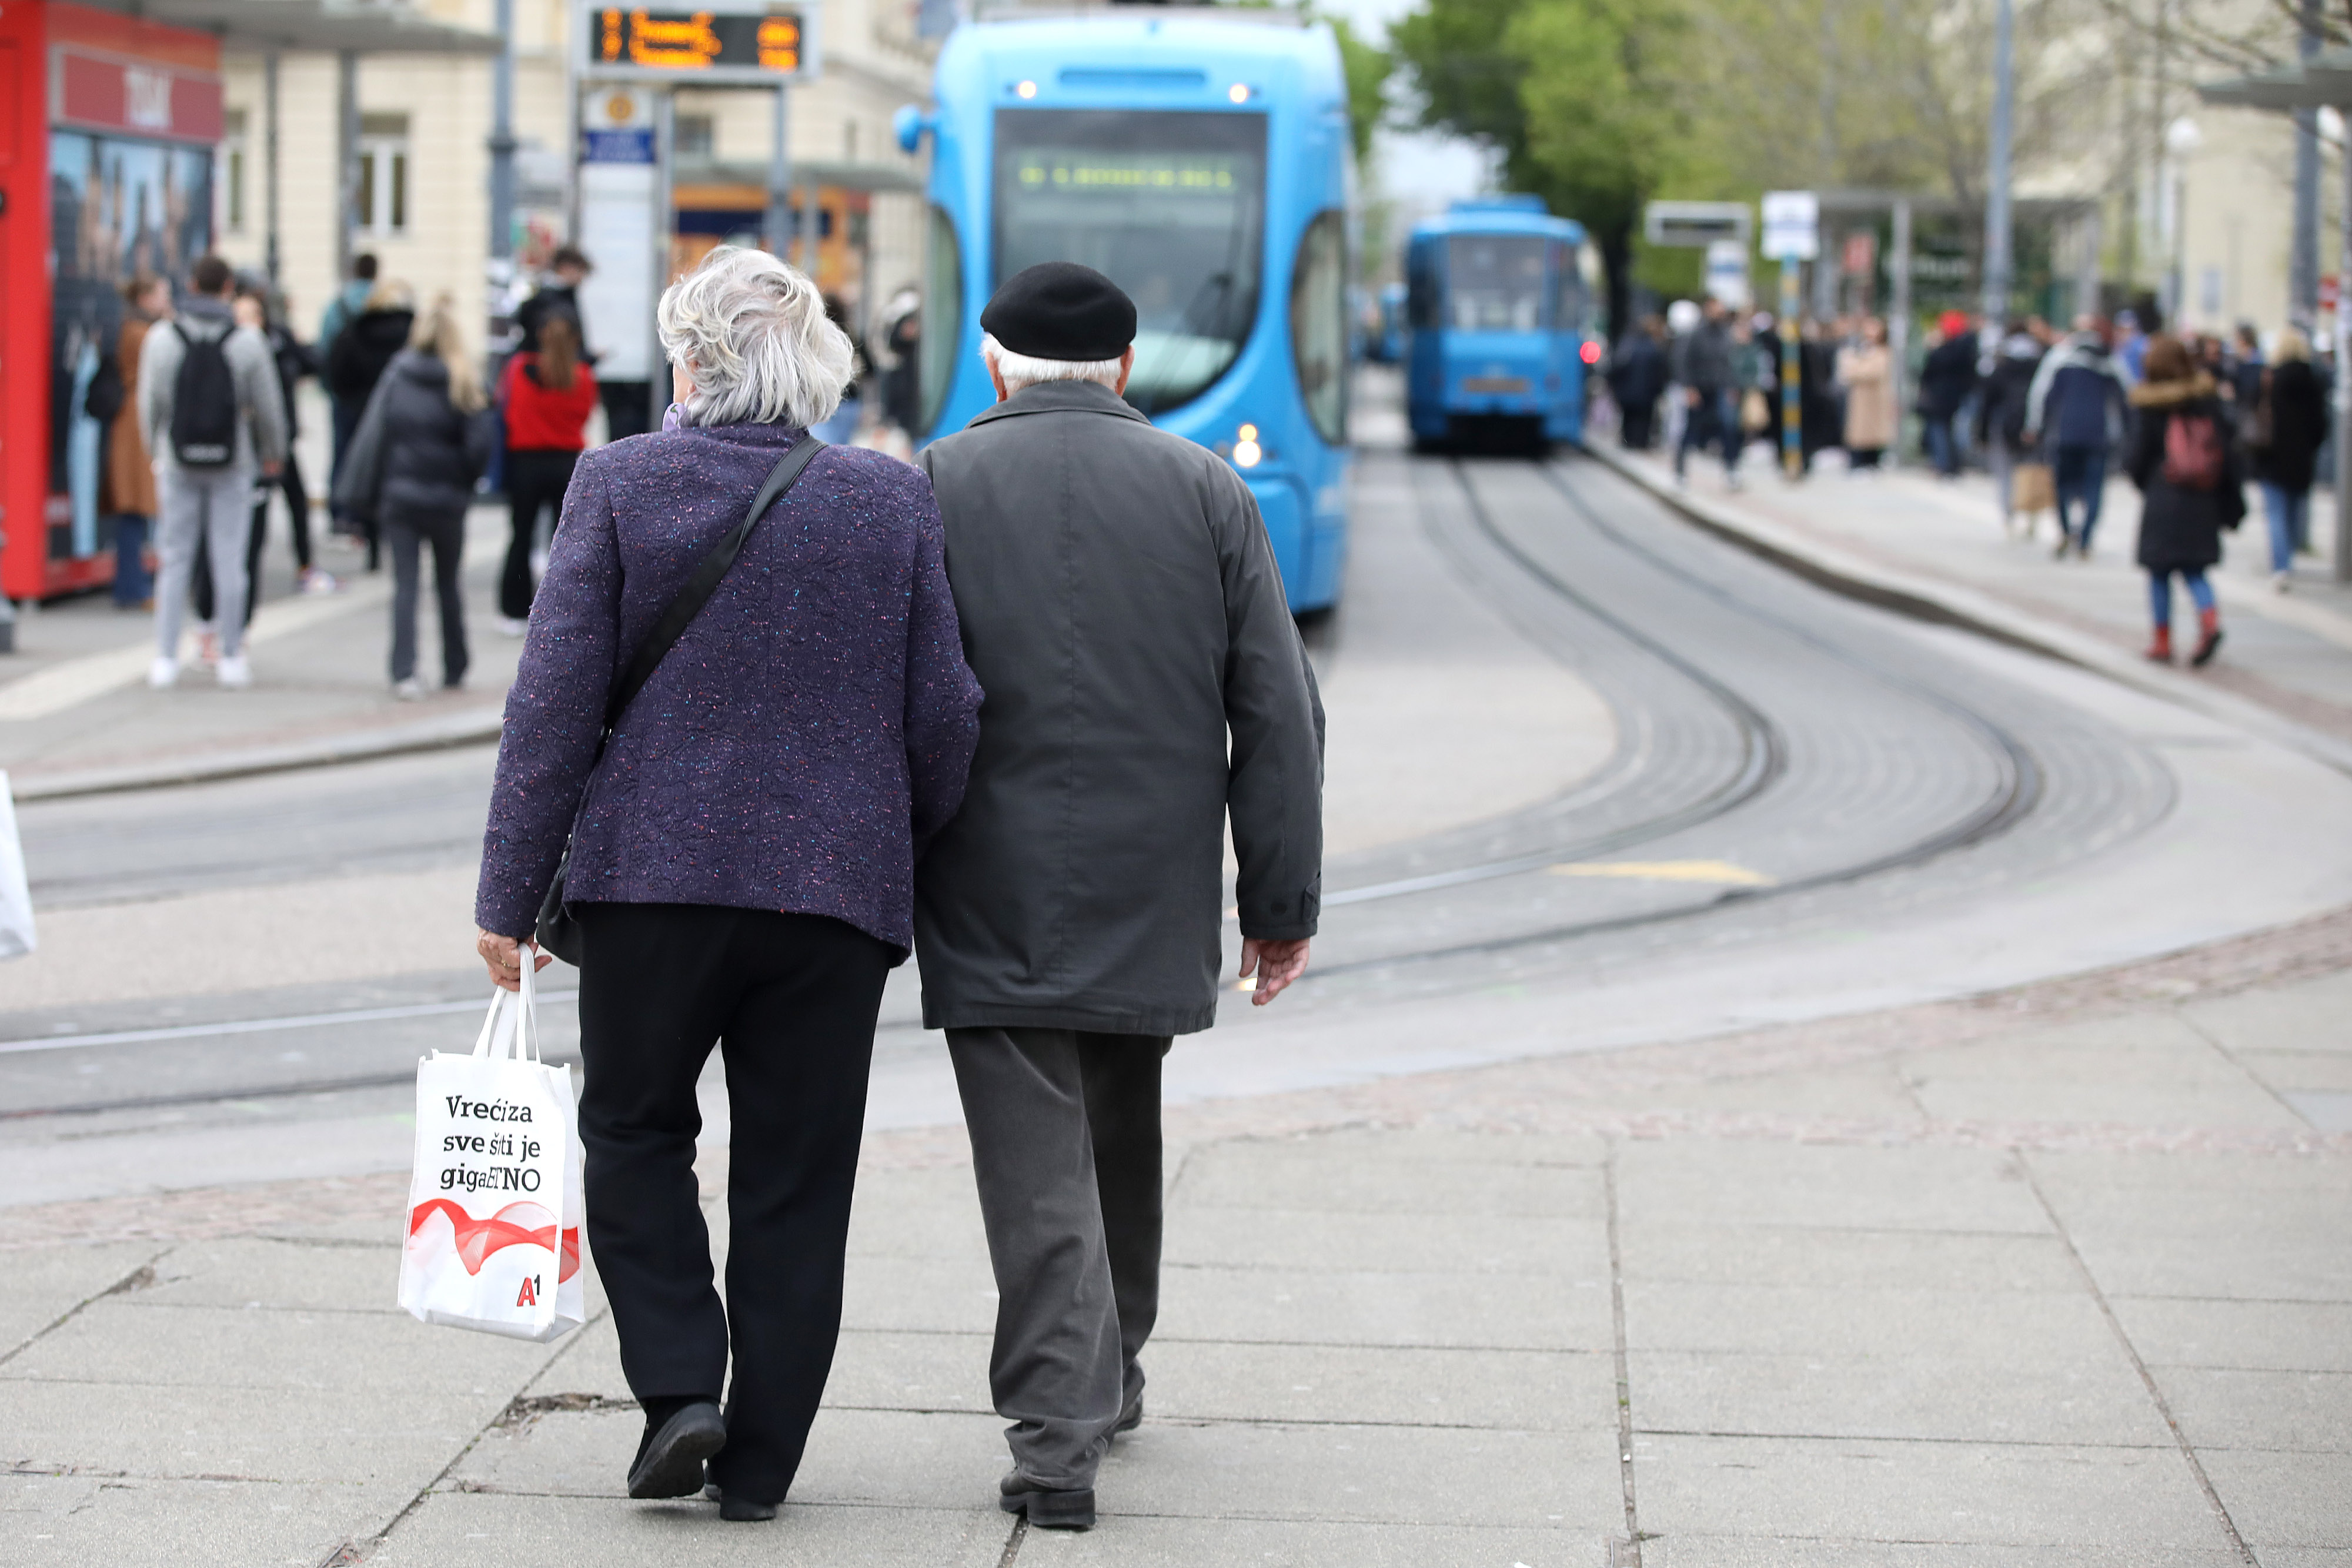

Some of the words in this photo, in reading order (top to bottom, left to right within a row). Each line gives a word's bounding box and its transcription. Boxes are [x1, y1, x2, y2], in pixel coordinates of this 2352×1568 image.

[443, 1135, 485, 1152] sve
[520, 1135, 540, 1162] je
[516, 1274, 540, 1307] A1
